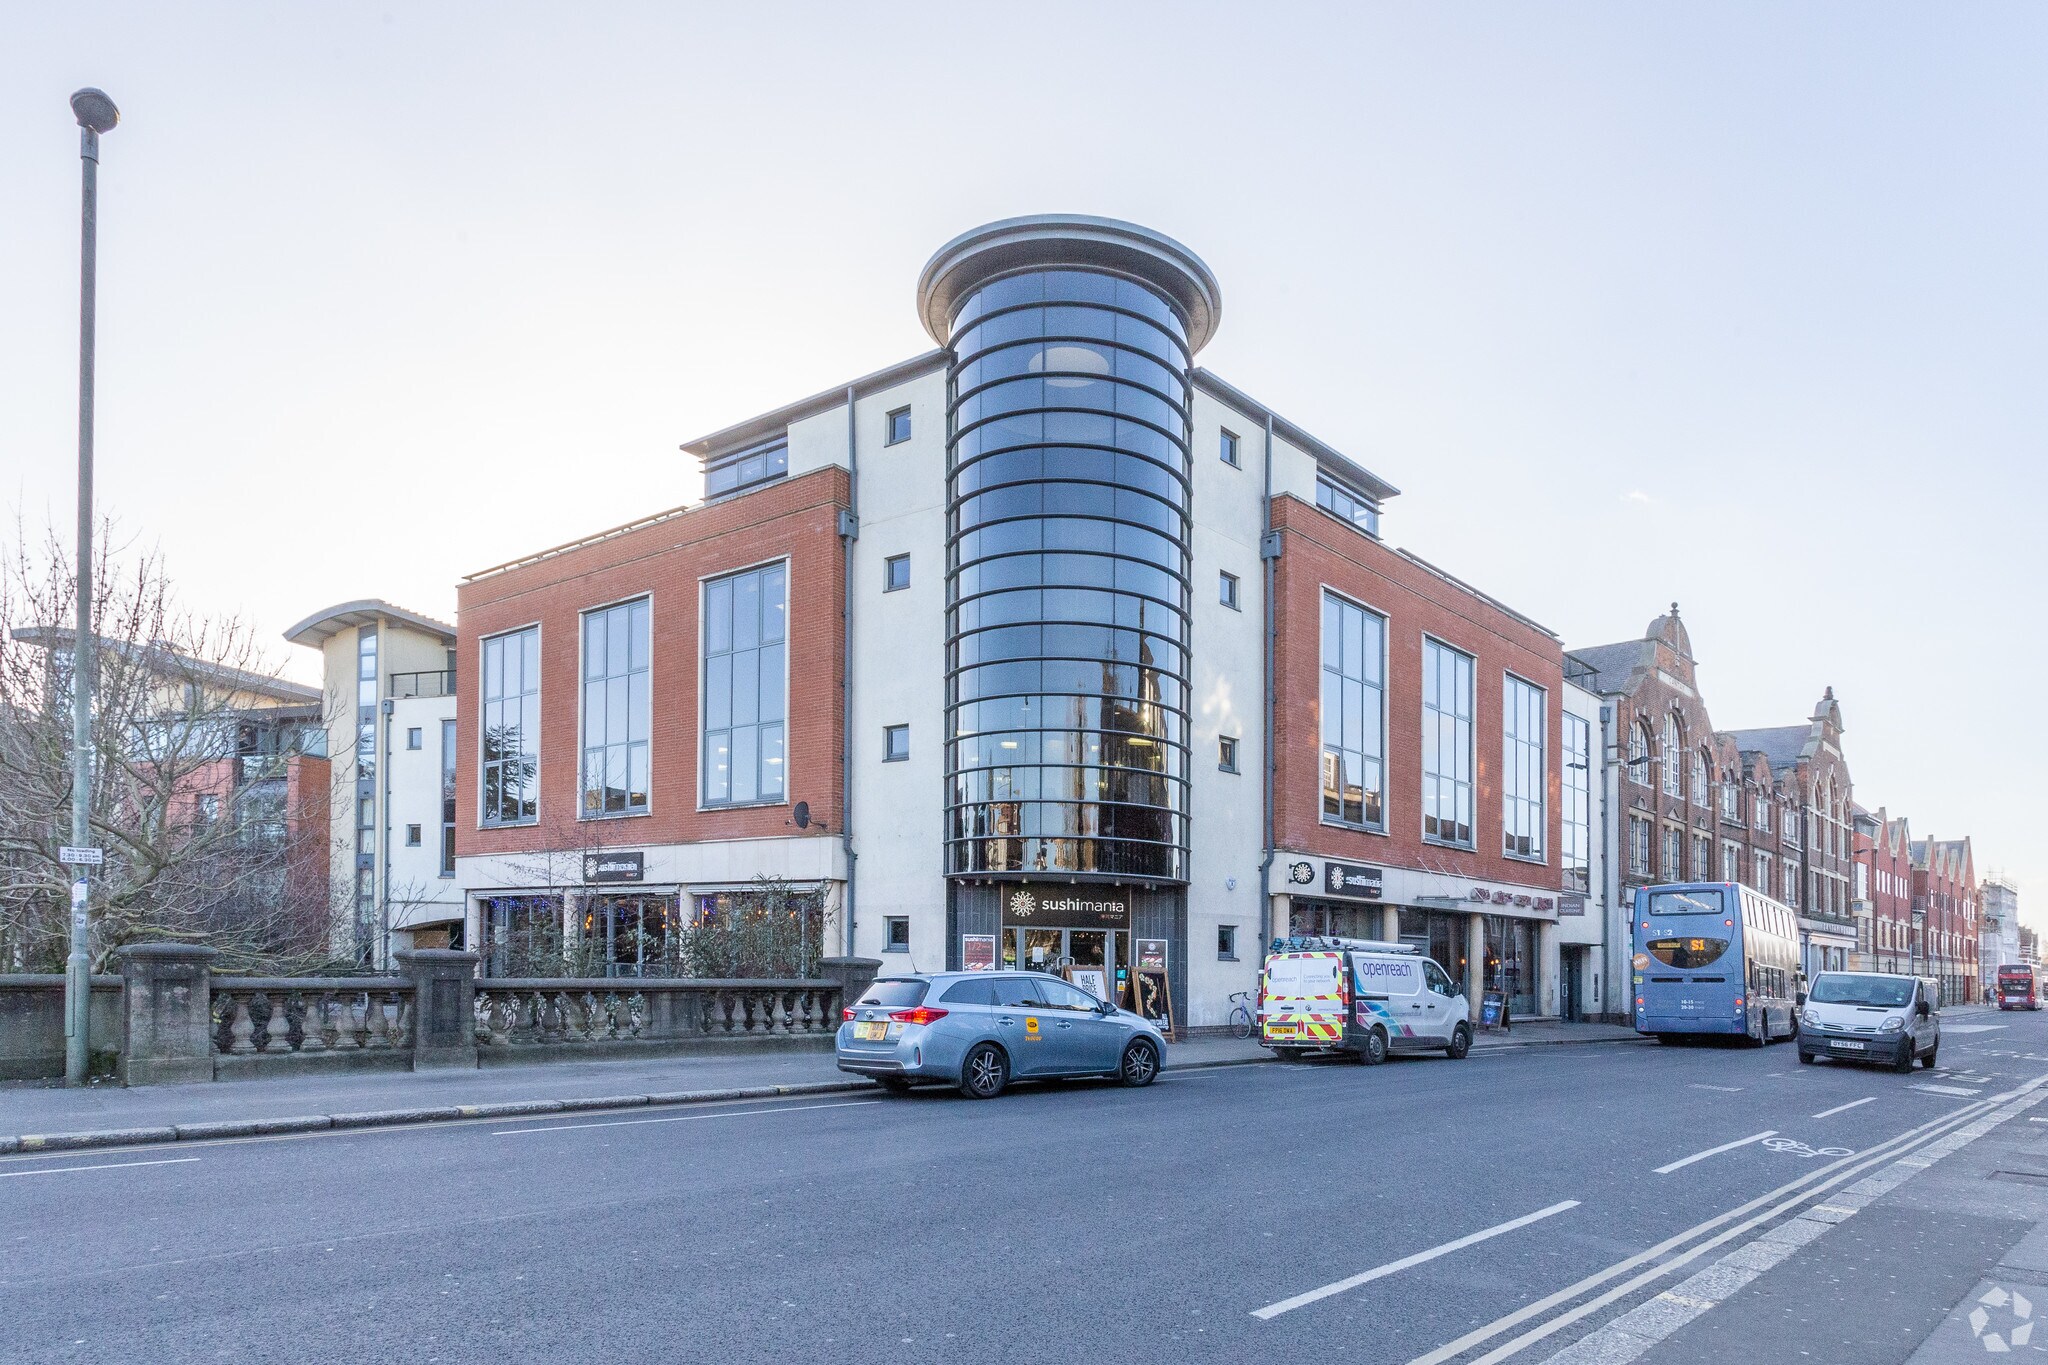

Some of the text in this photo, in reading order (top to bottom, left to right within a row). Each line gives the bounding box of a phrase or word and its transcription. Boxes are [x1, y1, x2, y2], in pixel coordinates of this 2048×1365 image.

[1042, 898, 1124, 912] sushimania
[1691, 939, 1705, 951] S1
[1363, 962, 1412, 978] openreach
[1081, 975, 1094, 985] HALF
[1272, 975, 1298, 984] openreach
[1083, 985, 1097, 993] PRICE
